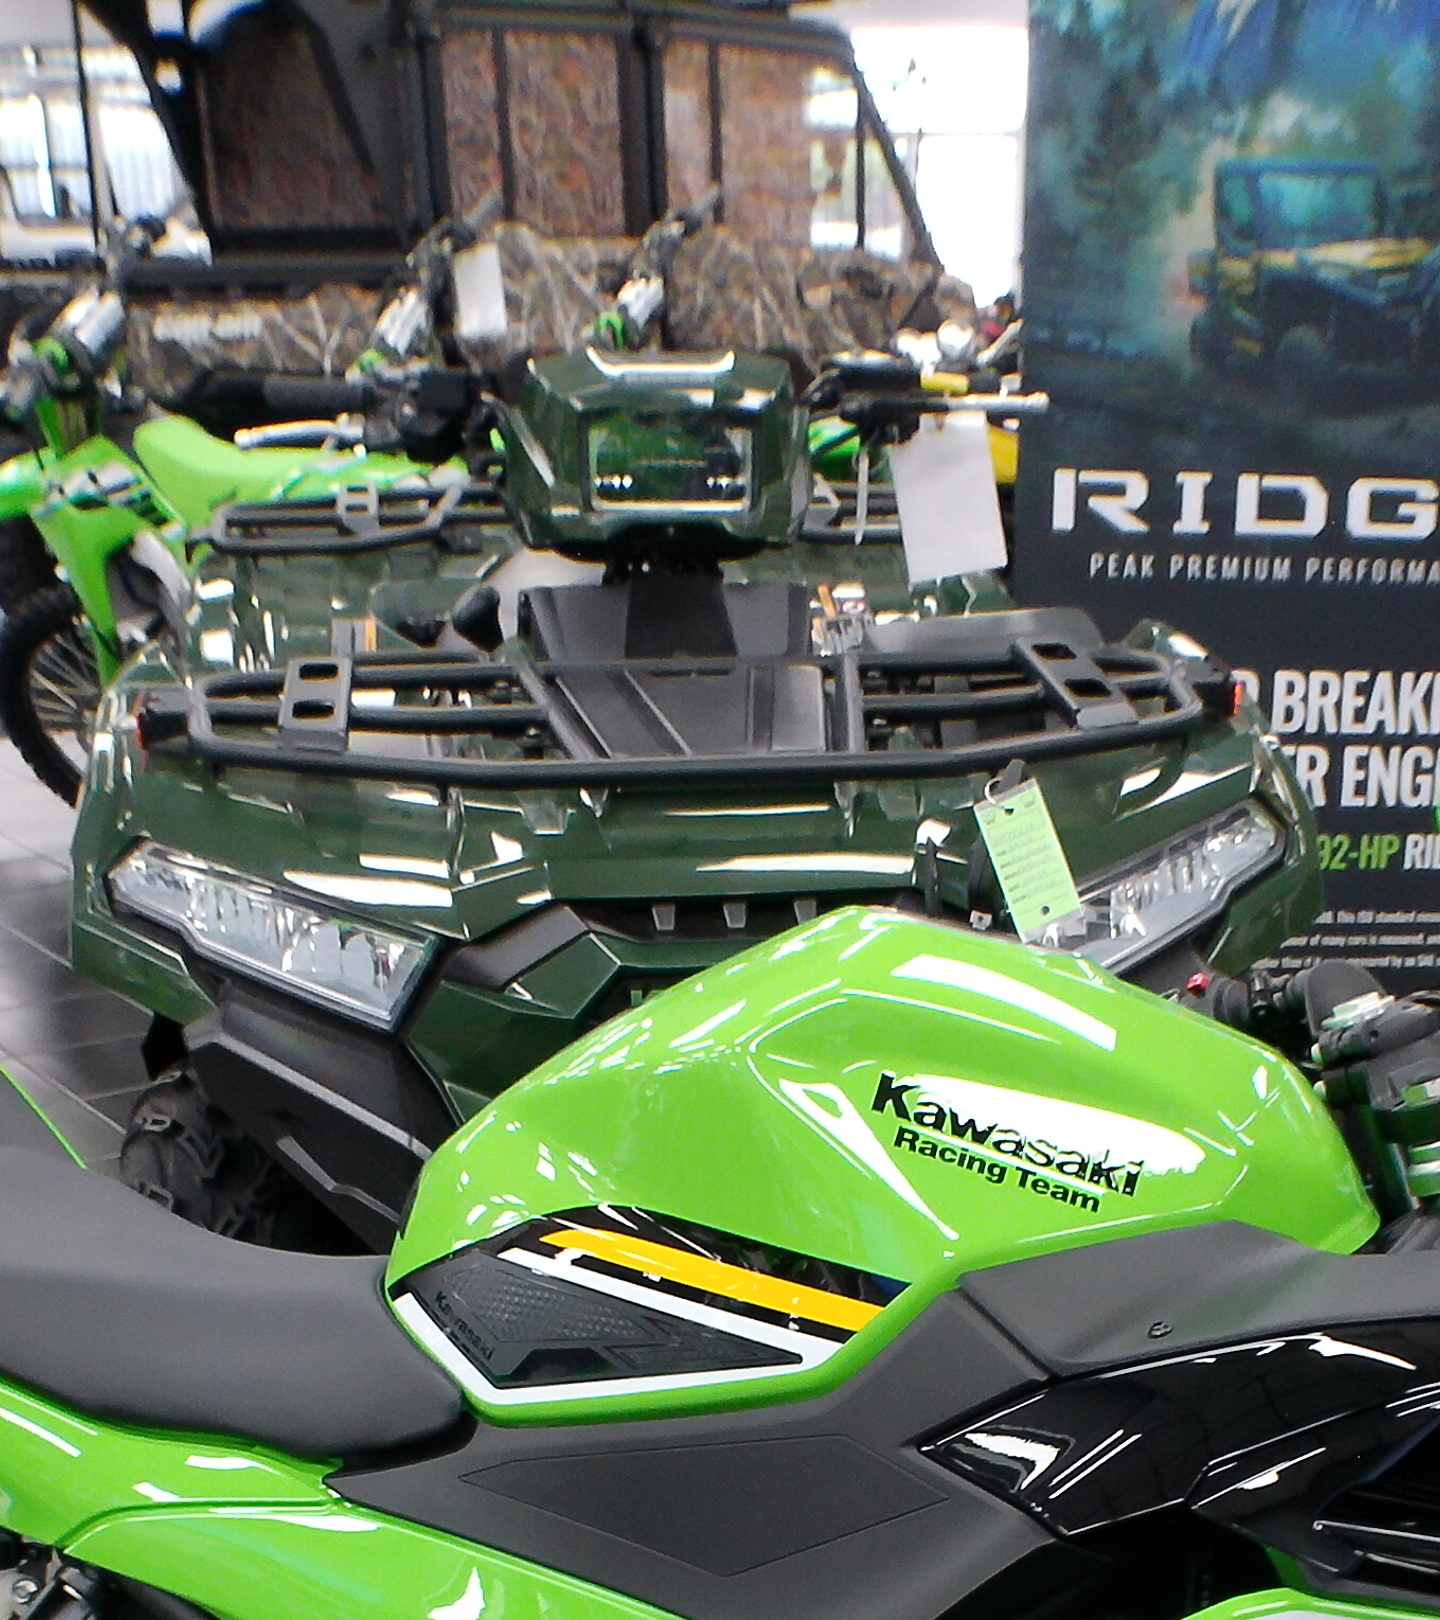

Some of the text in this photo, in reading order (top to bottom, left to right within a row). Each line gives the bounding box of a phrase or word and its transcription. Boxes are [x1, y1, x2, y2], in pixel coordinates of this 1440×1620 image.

[1088, 551, 1155, 580] PEAK
[1169, 553, 1293, 583] PREMIUM
[871, 1071, 1144, 1198] Kawasaki
[893, 1125, 1101, 1213] Racing Team
